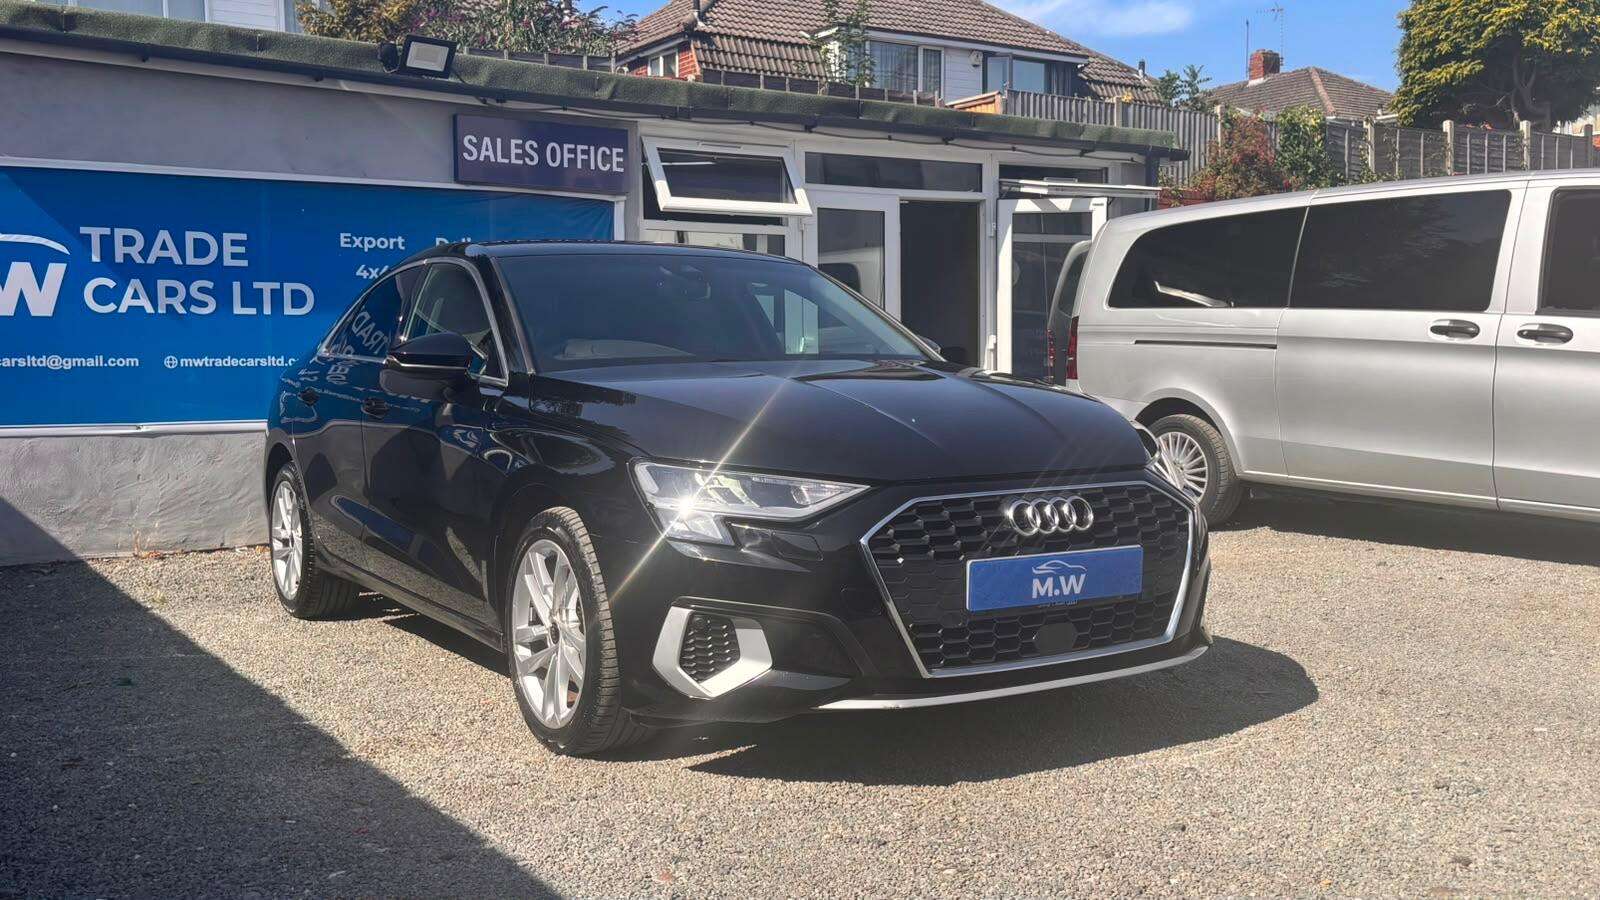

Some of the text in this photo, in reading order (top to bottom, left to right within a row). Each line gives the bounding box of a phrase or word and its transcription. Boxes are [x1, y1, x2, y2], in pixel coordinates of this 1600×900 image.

[462, 134, 625, 173] SALES OFFICE
[79, 226, 249, 267] TRADE
[339, 232, 406, 253] Export
[83, 277, 316, 316] CARS LTD
[1032, 573, 1086, 599] M.W
